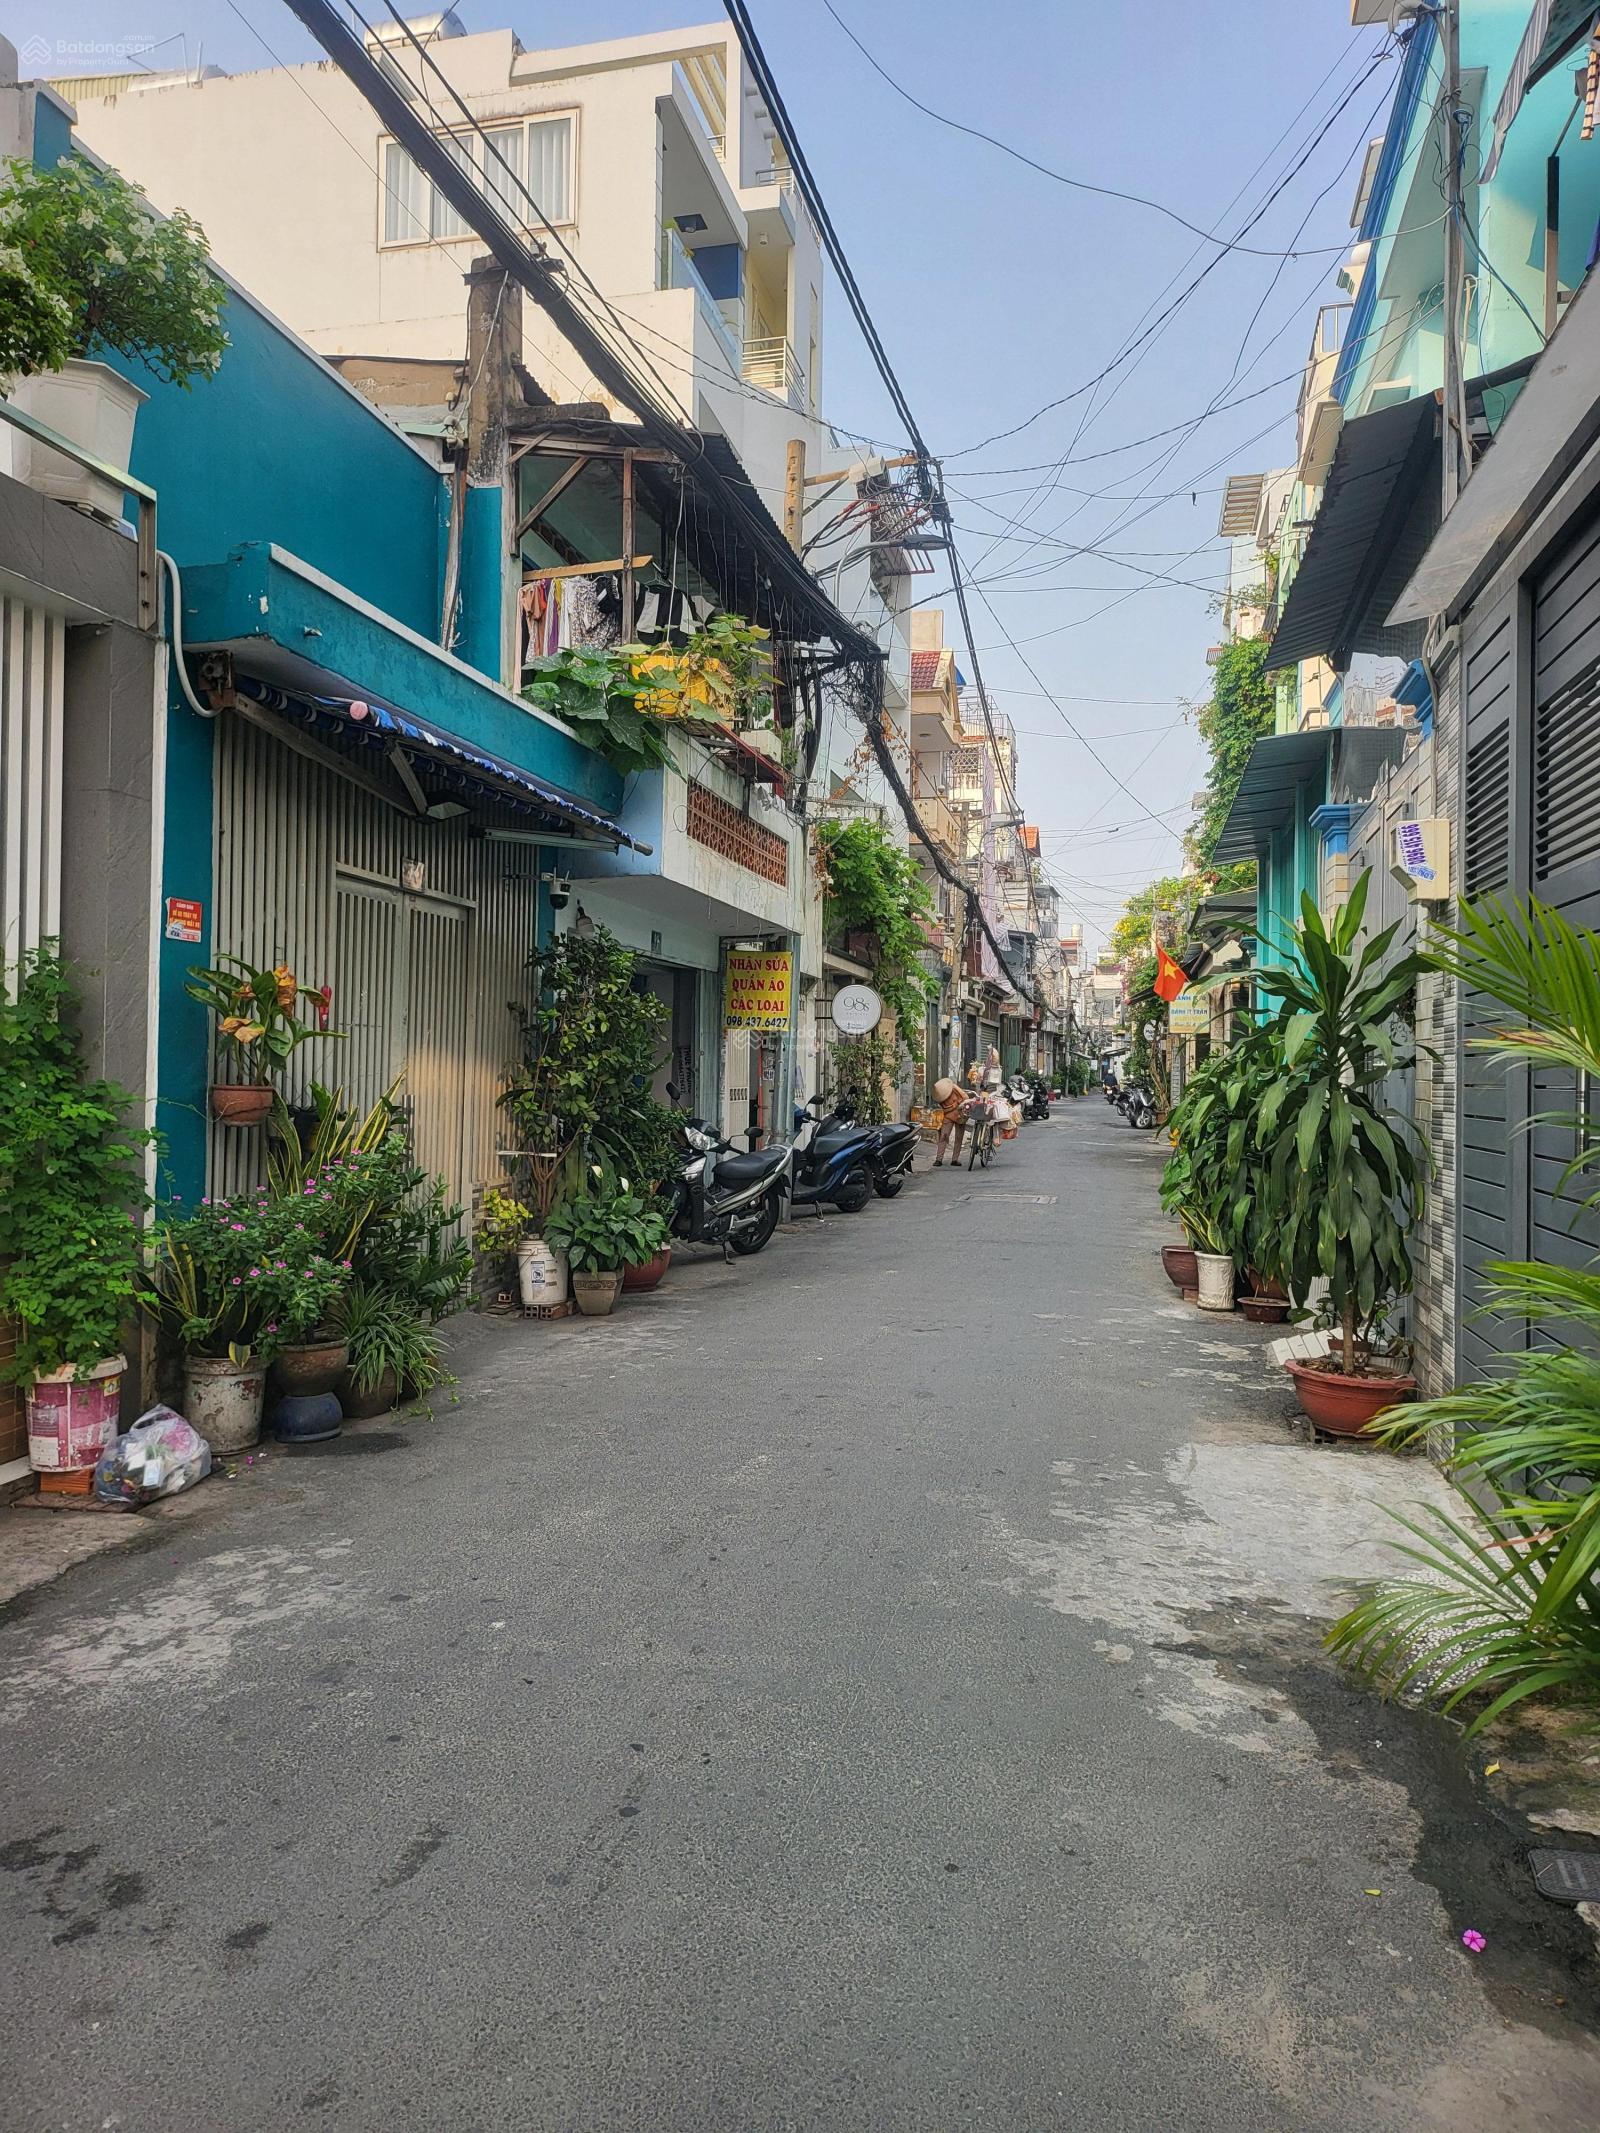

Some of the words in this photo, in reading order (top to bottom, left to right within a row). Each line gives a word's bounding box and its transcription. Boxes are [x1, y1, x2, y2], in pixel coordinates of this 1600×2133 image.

[729, 956, 762, 973] NHẬN
[765, 956, 789, 971] SỬA
[768, 977, 784, 991] ÁO
[731, 996, 754, 1011] CÁC
[757, 1000, 784, 1014] LOẠI
[726, 1016, 787, 1028] 098.437.6427
